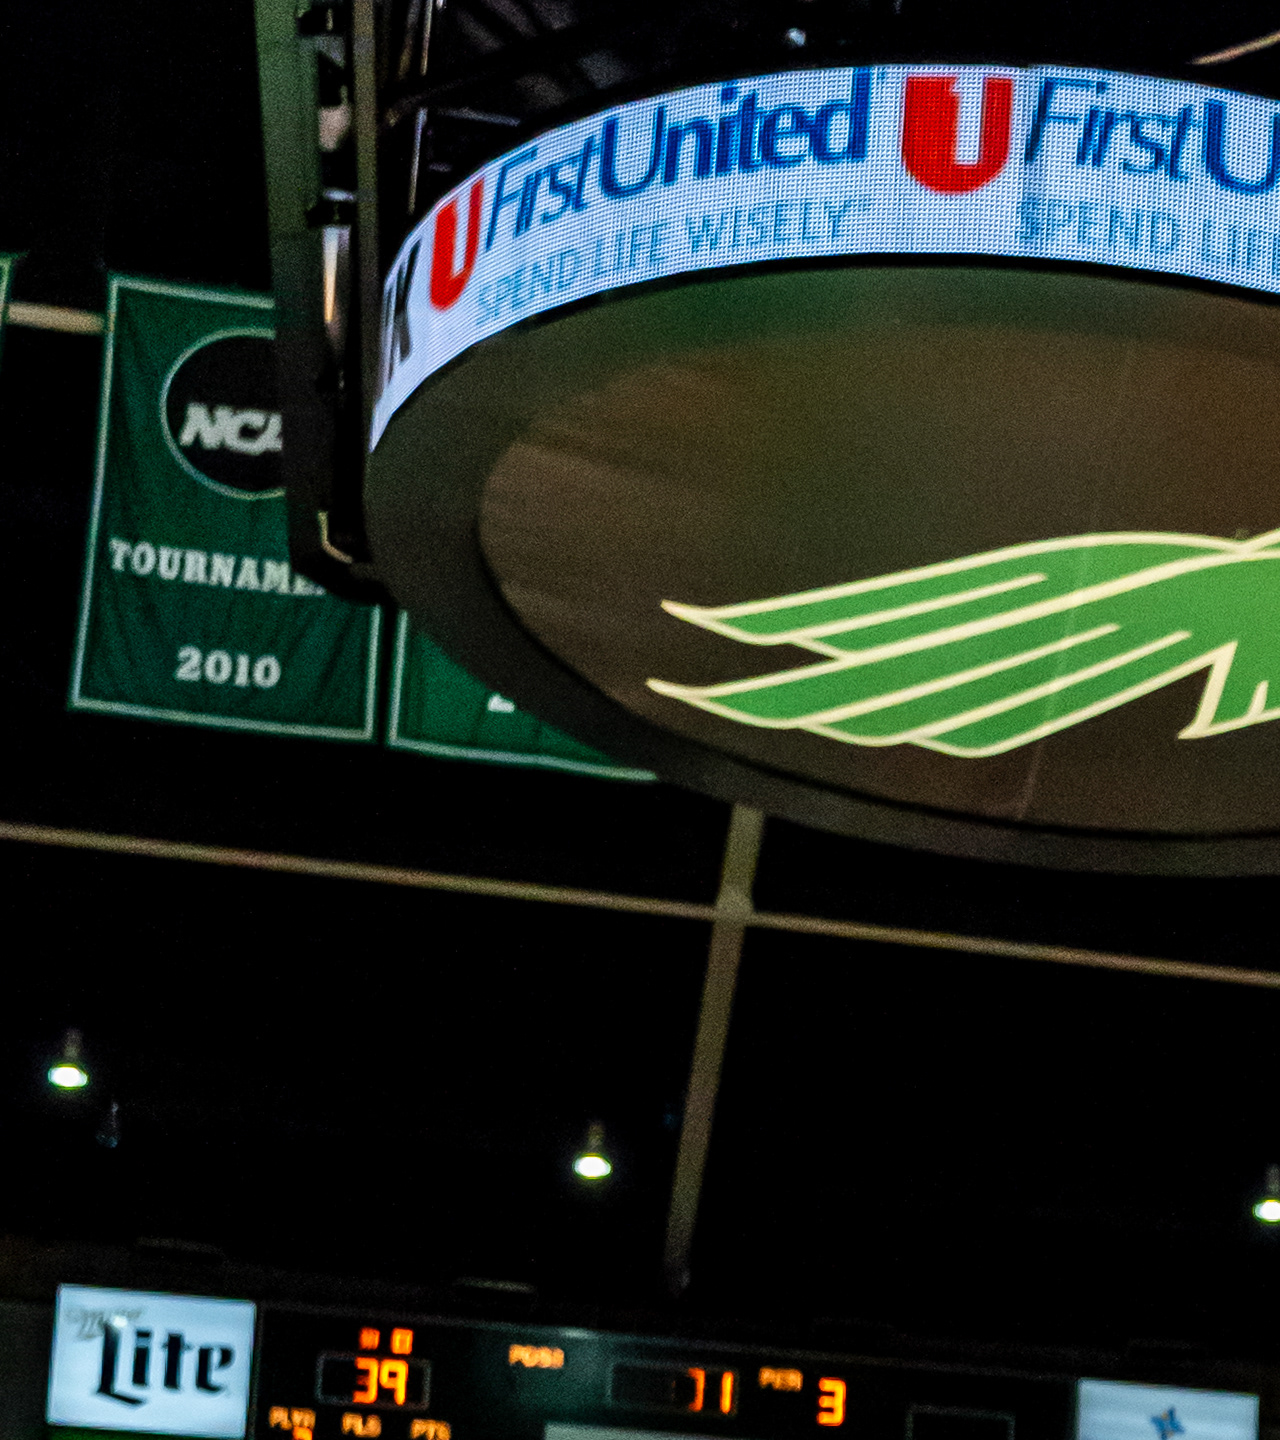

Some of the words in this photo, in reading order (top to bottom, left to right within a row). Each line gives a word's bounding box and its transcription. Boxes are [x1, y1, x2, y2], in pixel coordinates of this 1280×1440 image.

[1019, 198, 1182, 258] SPEND
[474, 249, 579, 327] SPEND
[600, 220, 667, 279] LIFE
[686, 198, 851, 254] WISELY
[178, 402, 284, 455] NCA
[108, 537, 328, 596] TOURNAM
[174, 645, 282, 689] 2010
[95, 1313, 237, 1406] Lite
[352, 1356, 409, 1406] 39
[816, 1376, 847, 1427] 3
